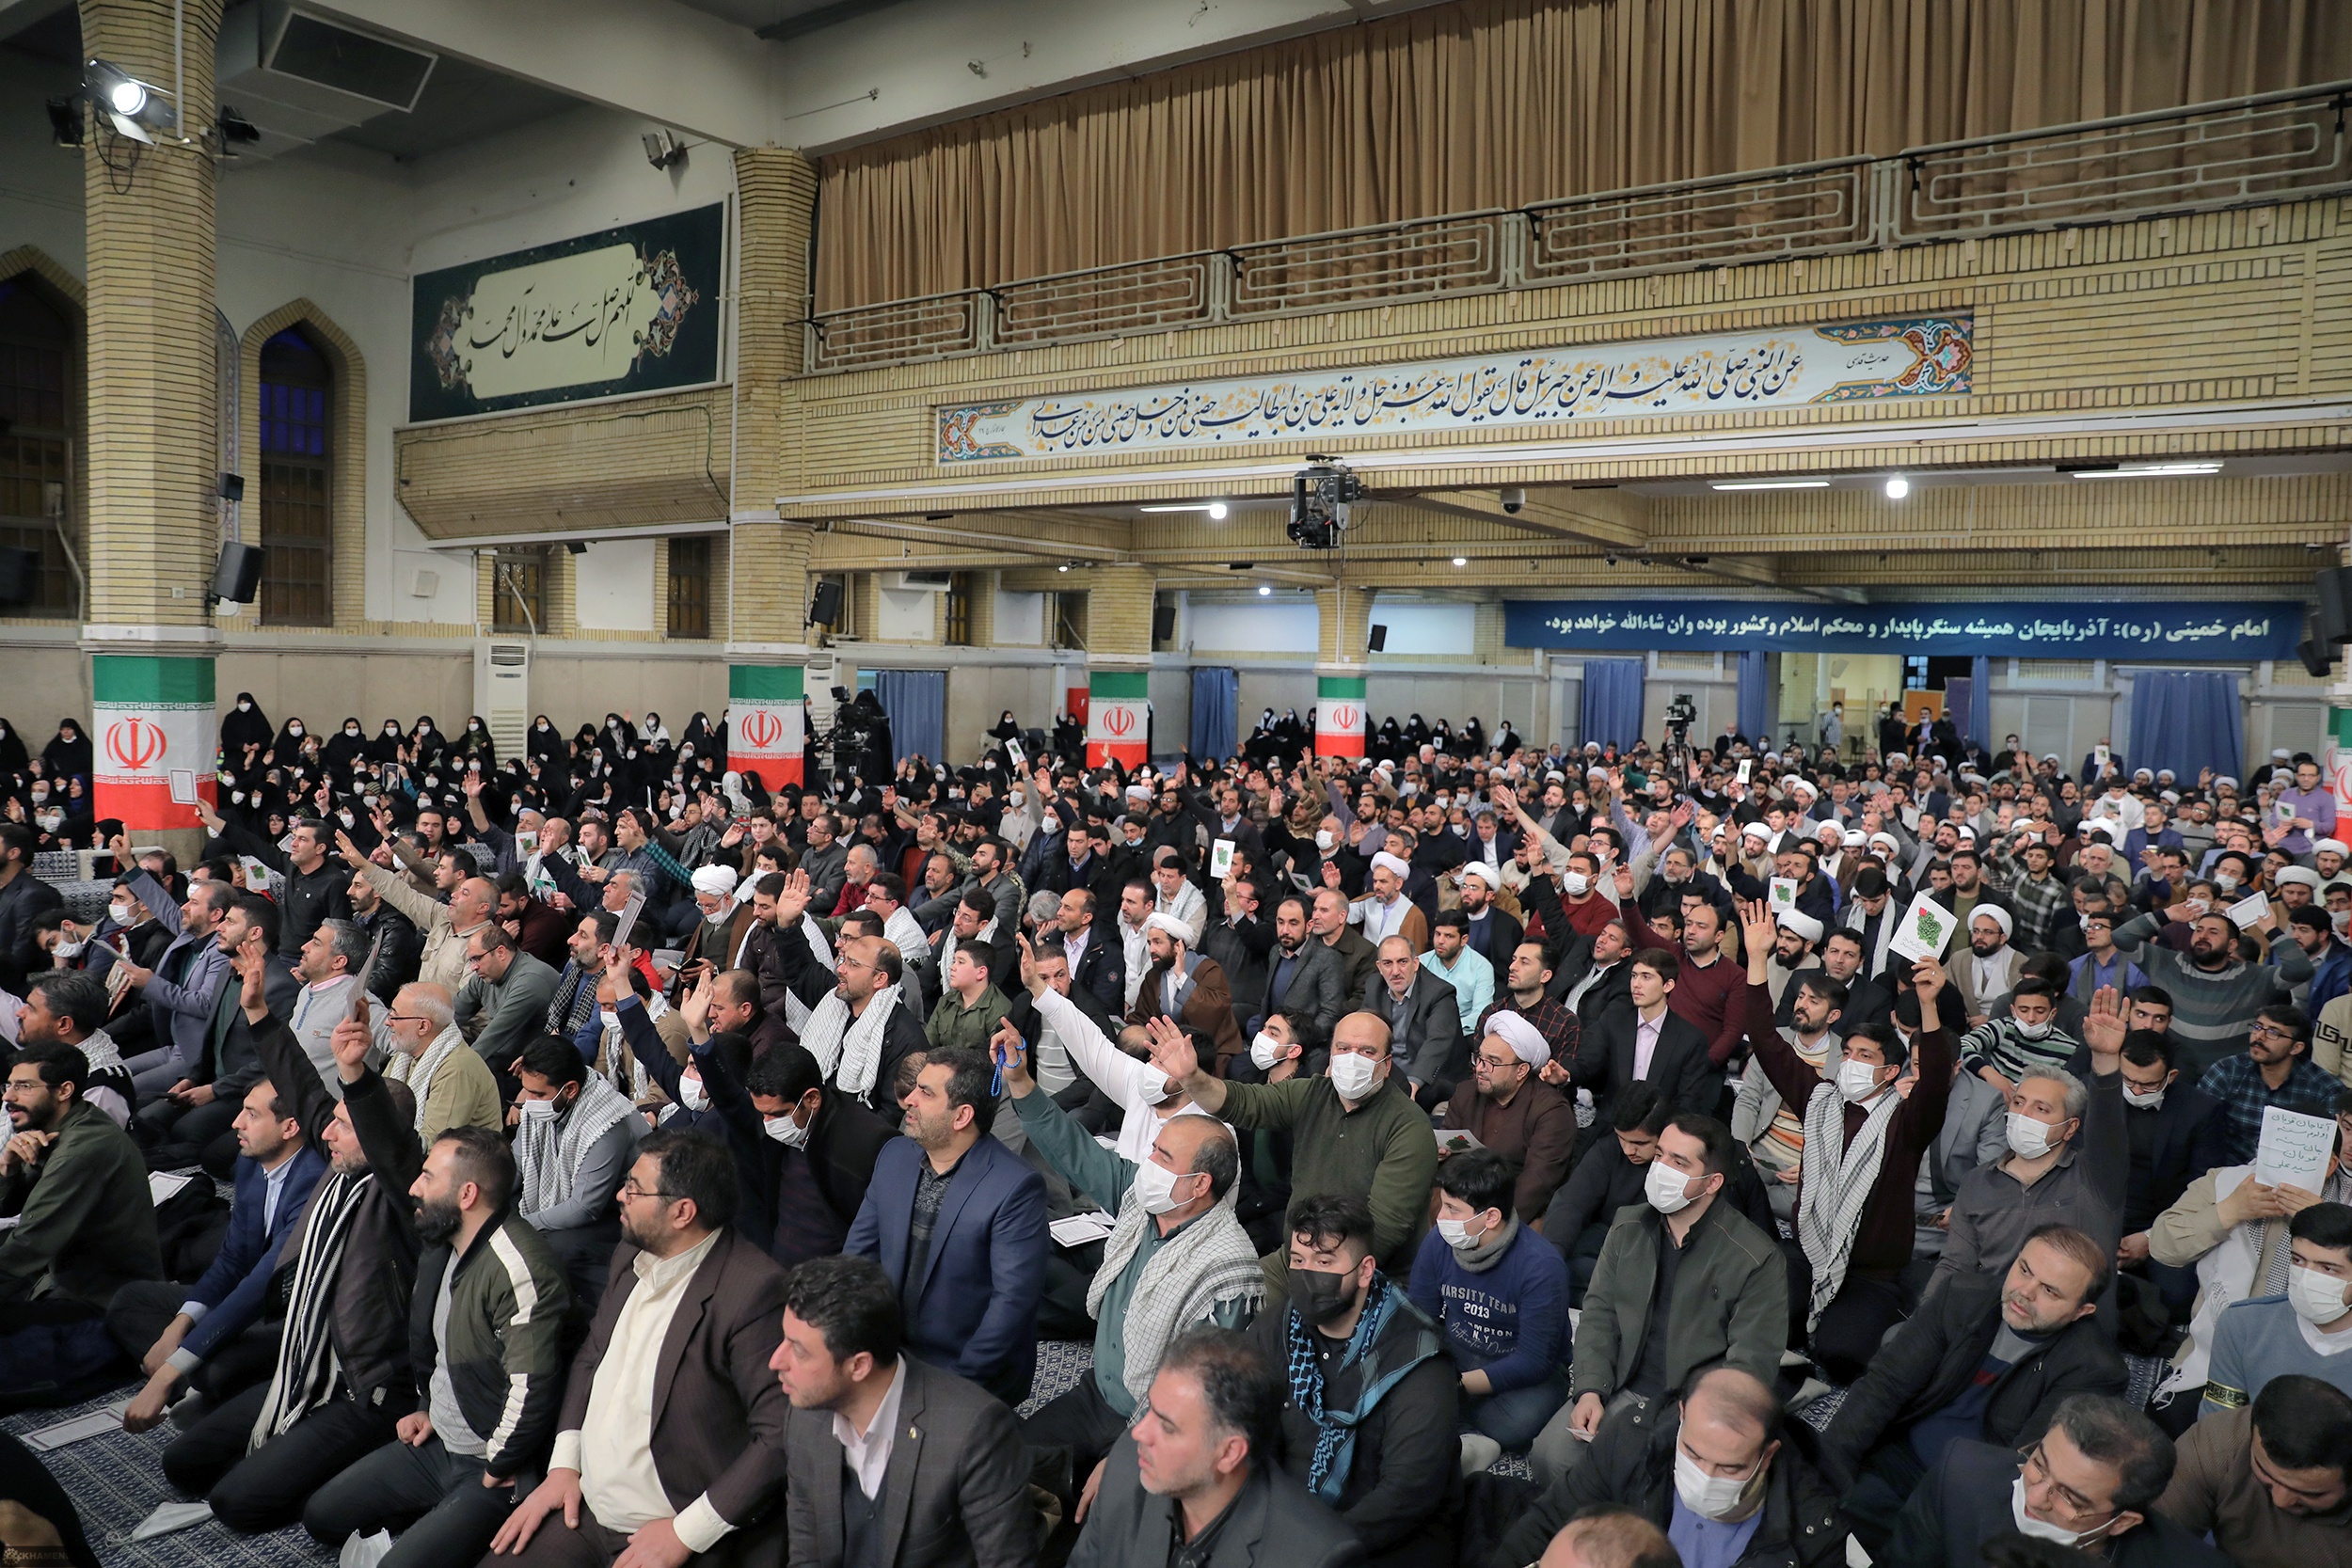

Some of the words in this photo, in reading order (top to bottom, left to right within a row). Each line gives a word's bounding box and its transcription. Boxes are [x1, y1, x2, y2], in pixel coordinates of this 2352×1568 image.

[1574, 612, 1616, 634] خواهد
[1696, 617, 1727, 635] بوده
[1779, 616, 1820, 636] اسلام
[1822, 617, 1865, 637] محکم
[1867, 626, 1878, 639] و
[1964, 618, 2015, 640] همیشه
[2018, 617, 2110, 642] آذربایجان
[2166, 618, 2228, 642] خمینی
[2231, 618, 2270, 641] امام
[1440, 1283, 1486, 1304] VARSITY
[1488, 1295, 1517, 1315] TEAM
[1463, 1302, 1490, 1319] 2013
